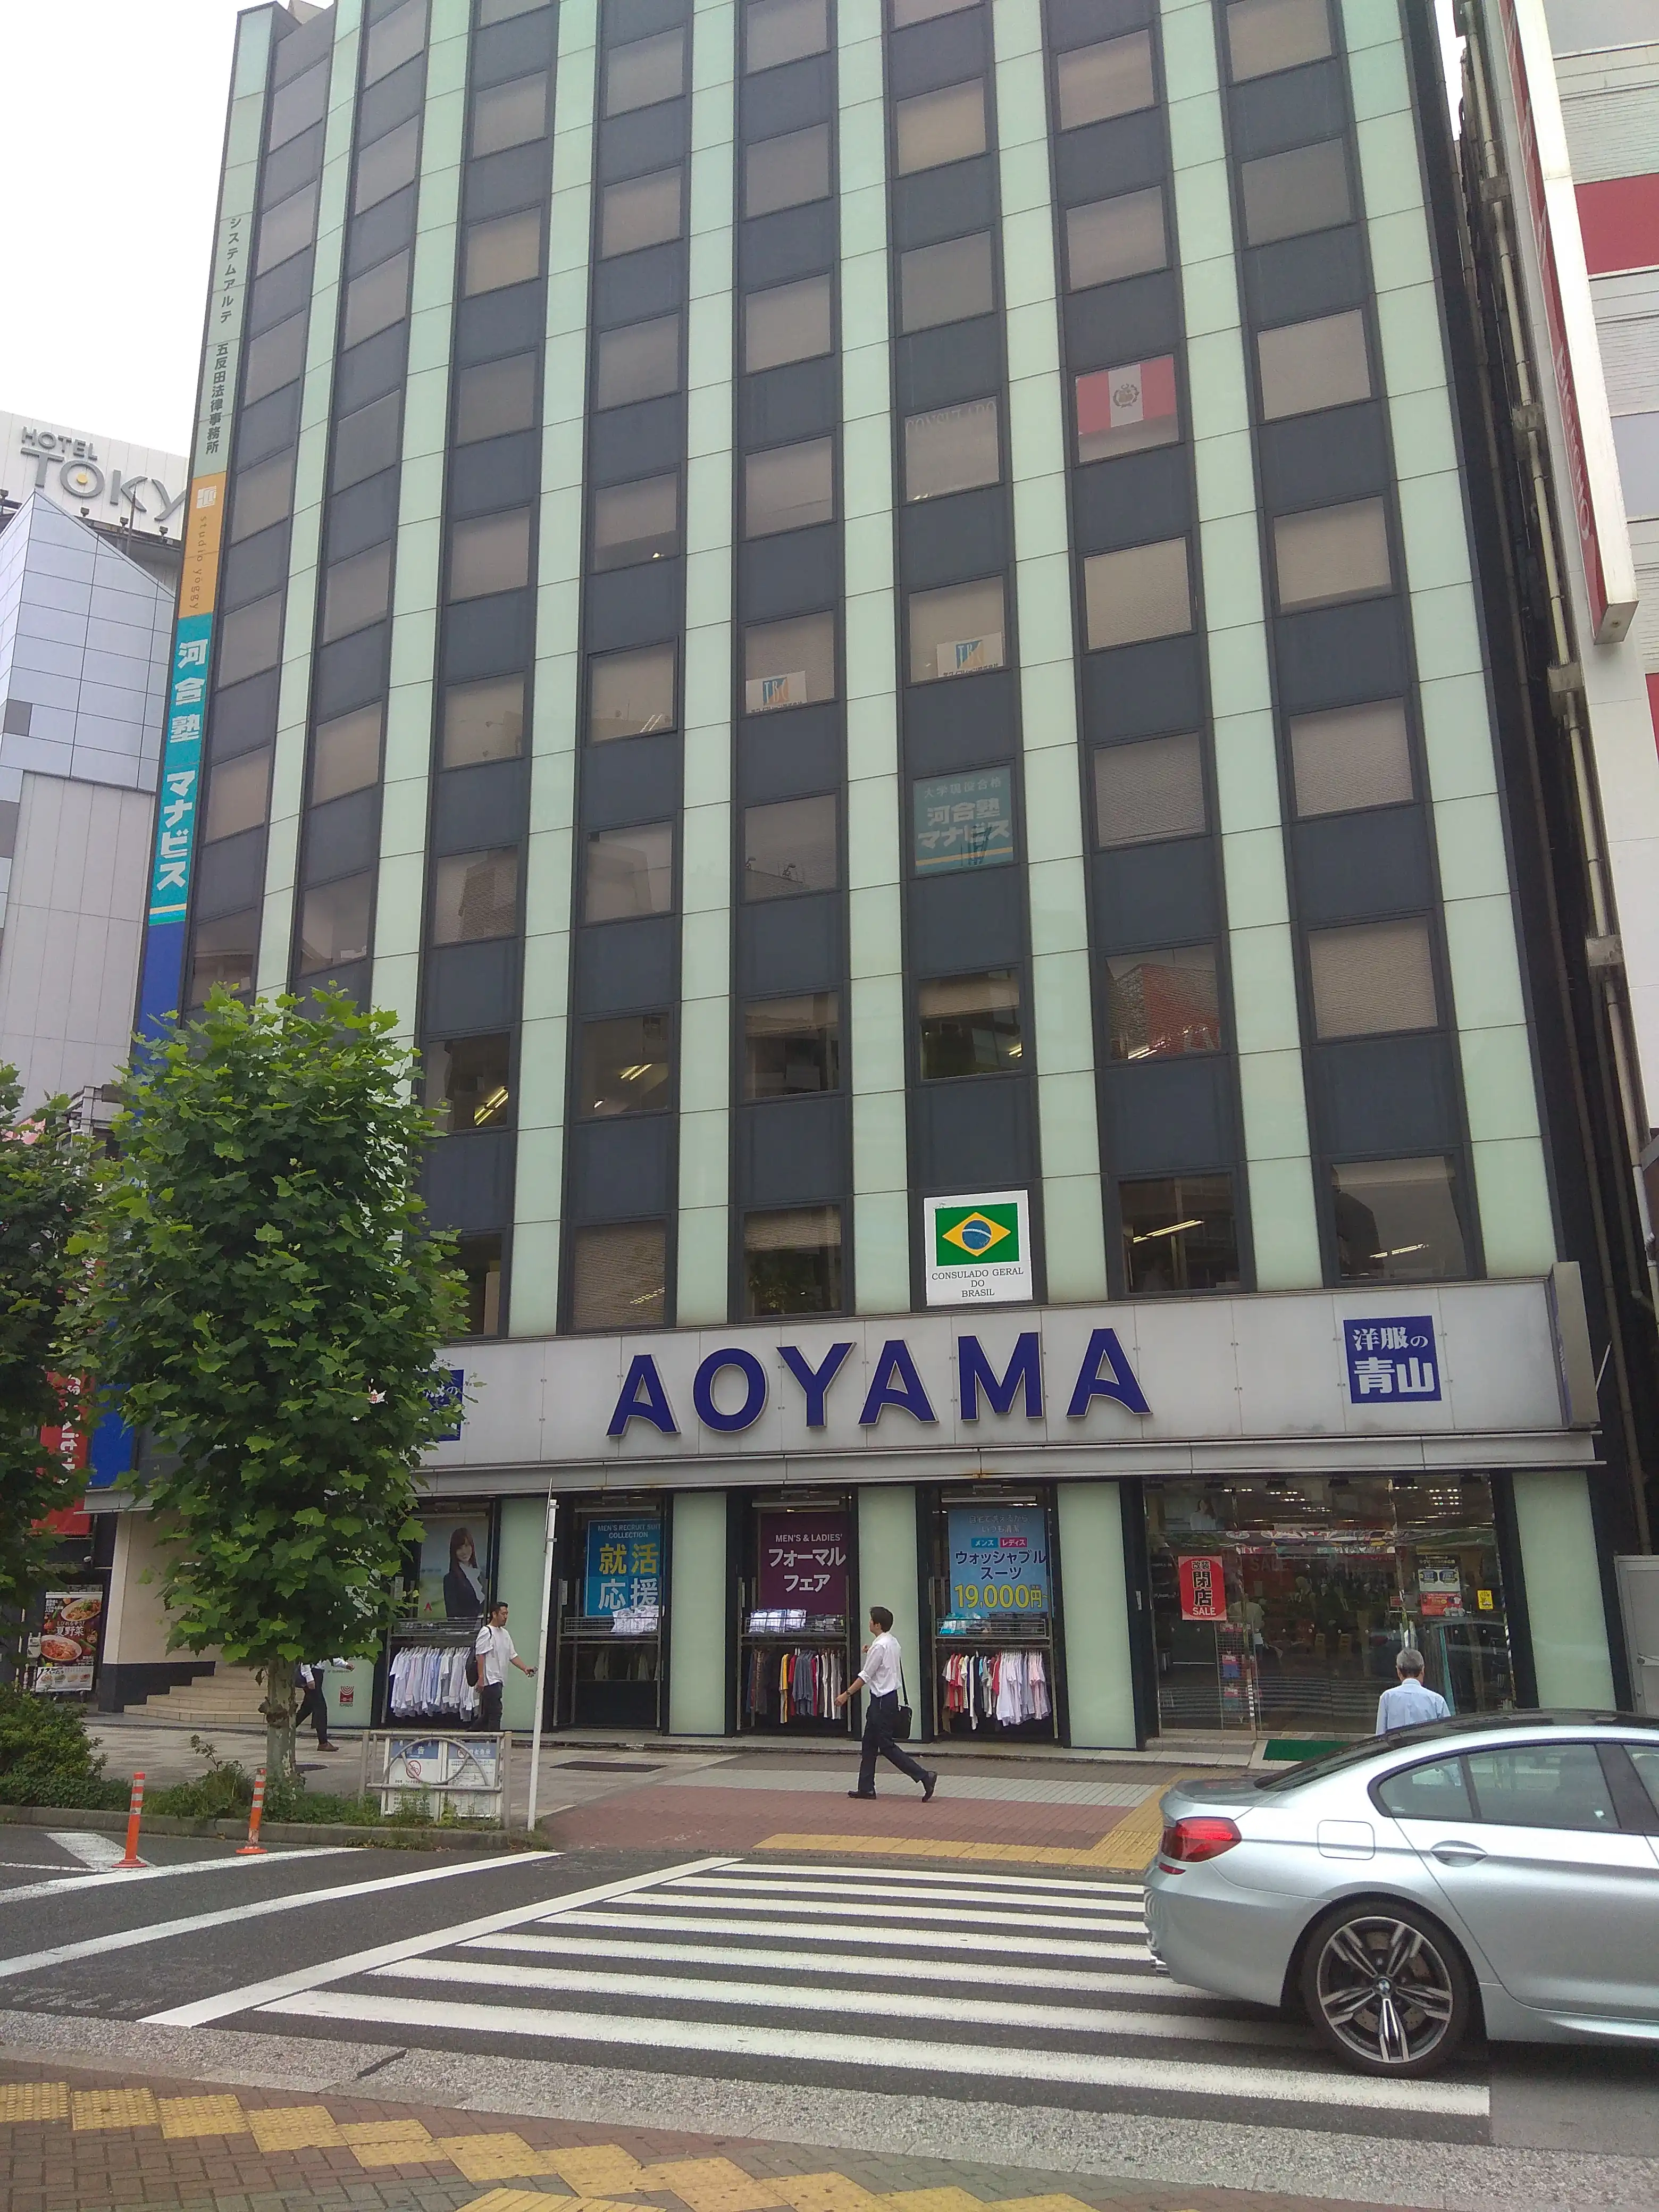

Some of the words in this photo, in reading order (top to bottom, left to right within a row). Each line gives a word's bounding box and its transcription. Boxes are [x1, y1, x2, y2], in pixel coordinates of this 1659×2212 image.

[220, 218, 241, 323] システムアルテ
[206, 342, 229, 455] 五反田法律事務所
[21, 426, 98, 460] HOTEL
[196, 515, 207, 562] studio
[170, 638, 209, 742] 河合塾
[927, 797, 1001, 827] 河合塾
[156, 769, 196, 891] マナビス
[917, 819, 1010, 849] マナビス
[932, 1269, 989, 1280] CONSULADO
[992, 1267, 1024, 1277] GERAL
[961, 1288, 995, 1297] BRASIL
[1352, 1326, 1429, 1352] 洋服の
[606, 1327, 1153, 1437] AOYAMA
[1354, 1356, 1435, 1395] 青山
[599, 1543, 659, 1575] 就活
[768, 1547, 846, 1567] フォーマル
[955, 1549, 1047, 1565] ウォッシャブル
[1192, 1561, 1210, 1570] 改装
[784, 1574, 831, 1592] フェア
[980, 1566, 1022, 1580] スーツ
[598, 1578, 659, 1610] 応援
[1192, 1570, 1213, 1607] 閉店
[1192, 1607, 1216, 1615] SALE
[55, 1626, 85, 1637] 夏野菜
